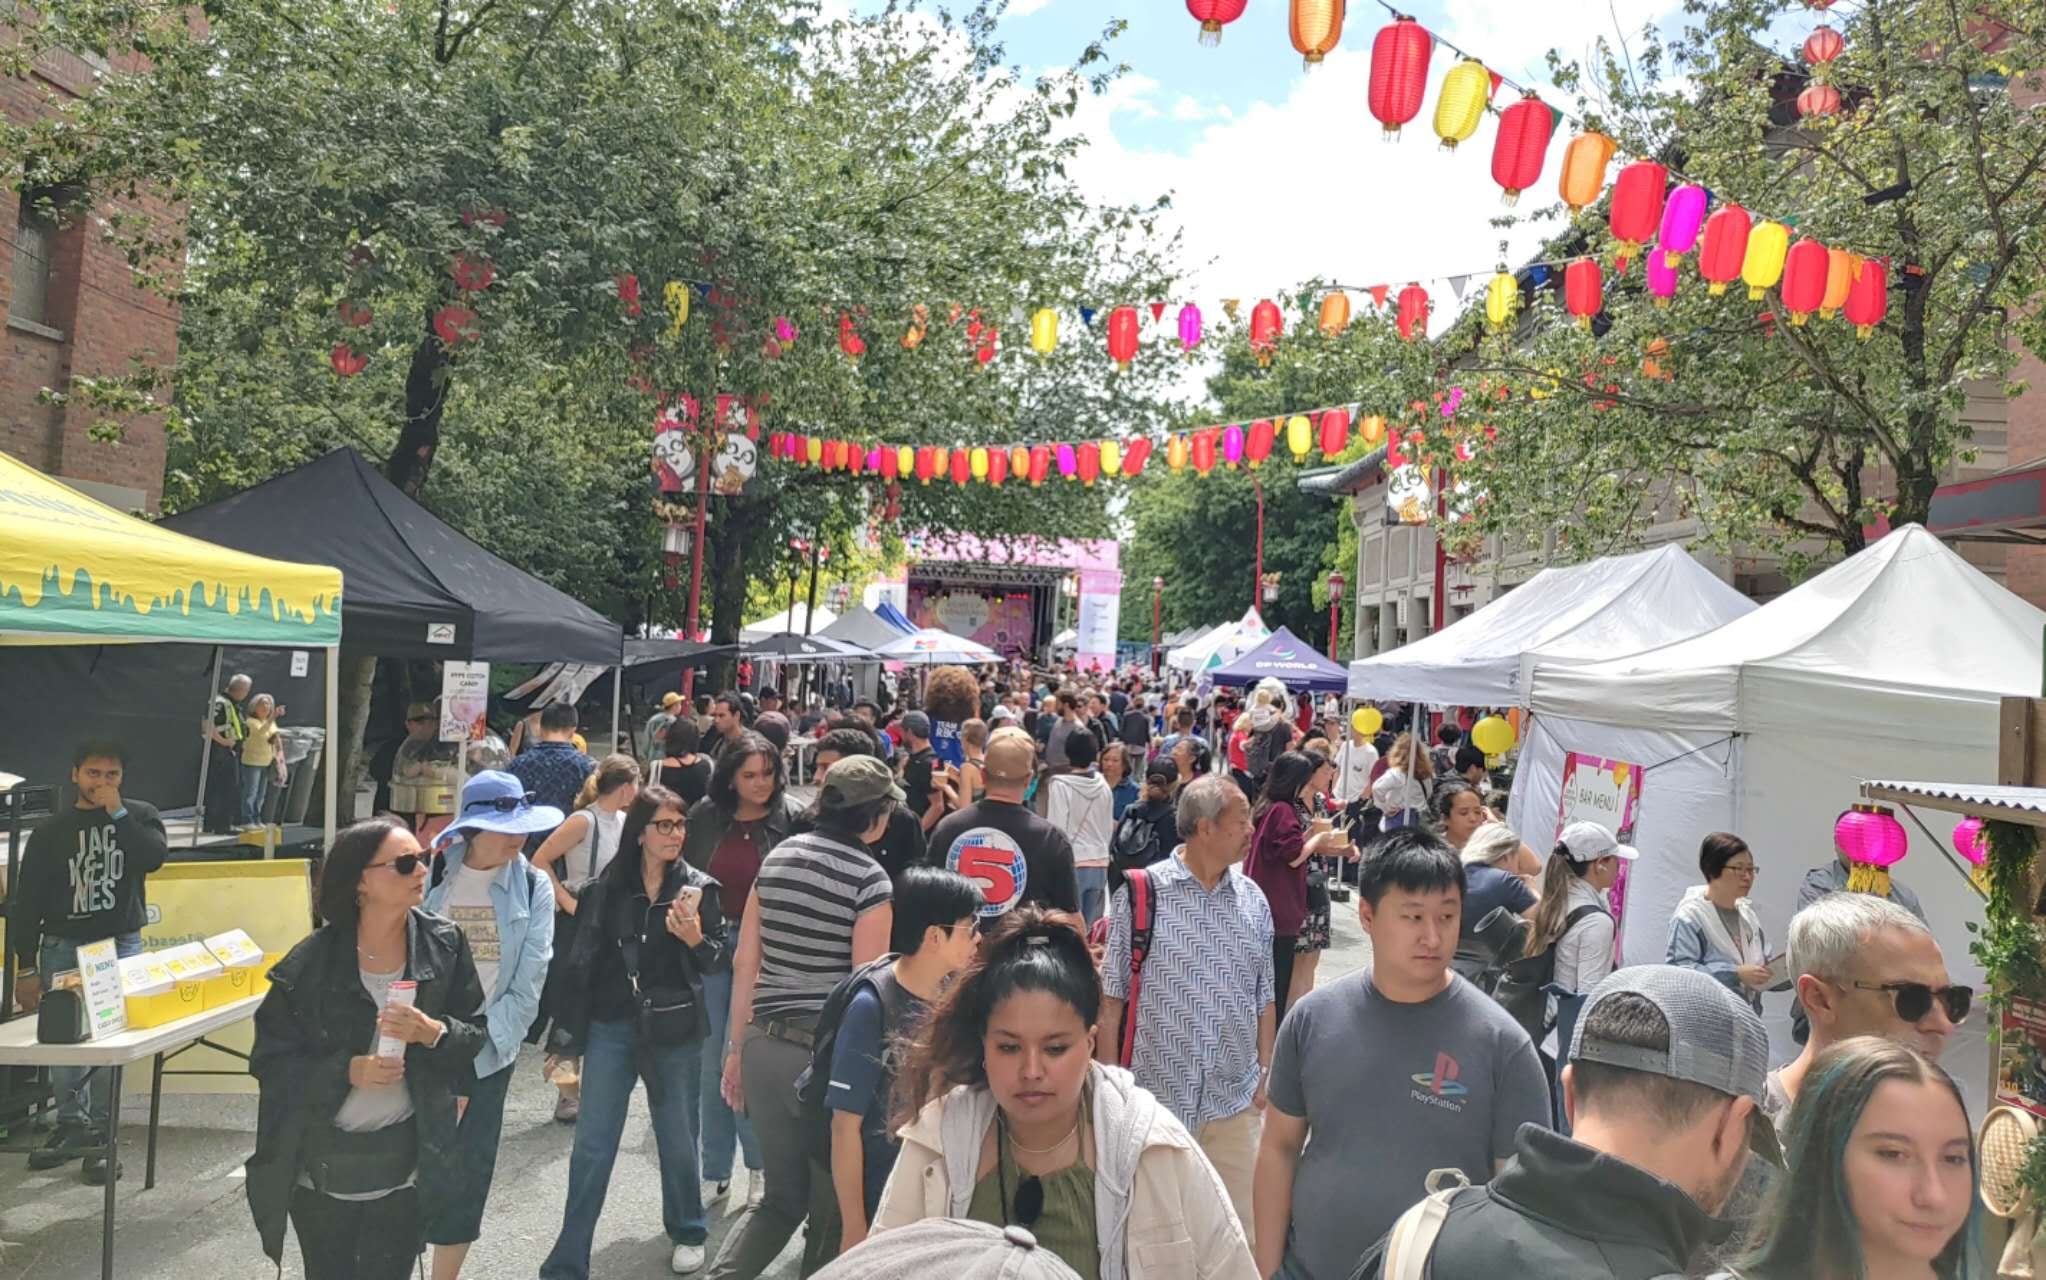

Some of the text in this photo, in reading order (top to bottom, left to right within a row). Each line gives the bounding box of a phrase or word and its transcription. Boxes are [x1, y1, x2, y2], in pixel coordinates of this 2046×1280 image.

[1256, 661, 1318, 670] DP WORLD
[936, 727, 956, 739] RBC
[938, 720, 957, 730] TEAM
[1579, 788, 1593, 807] BAR
[1593, 793, 1616, 812] MENU
[959, 846, 1016, 905] 5
[1410, 1089, 1462, 1113] PlayStation
